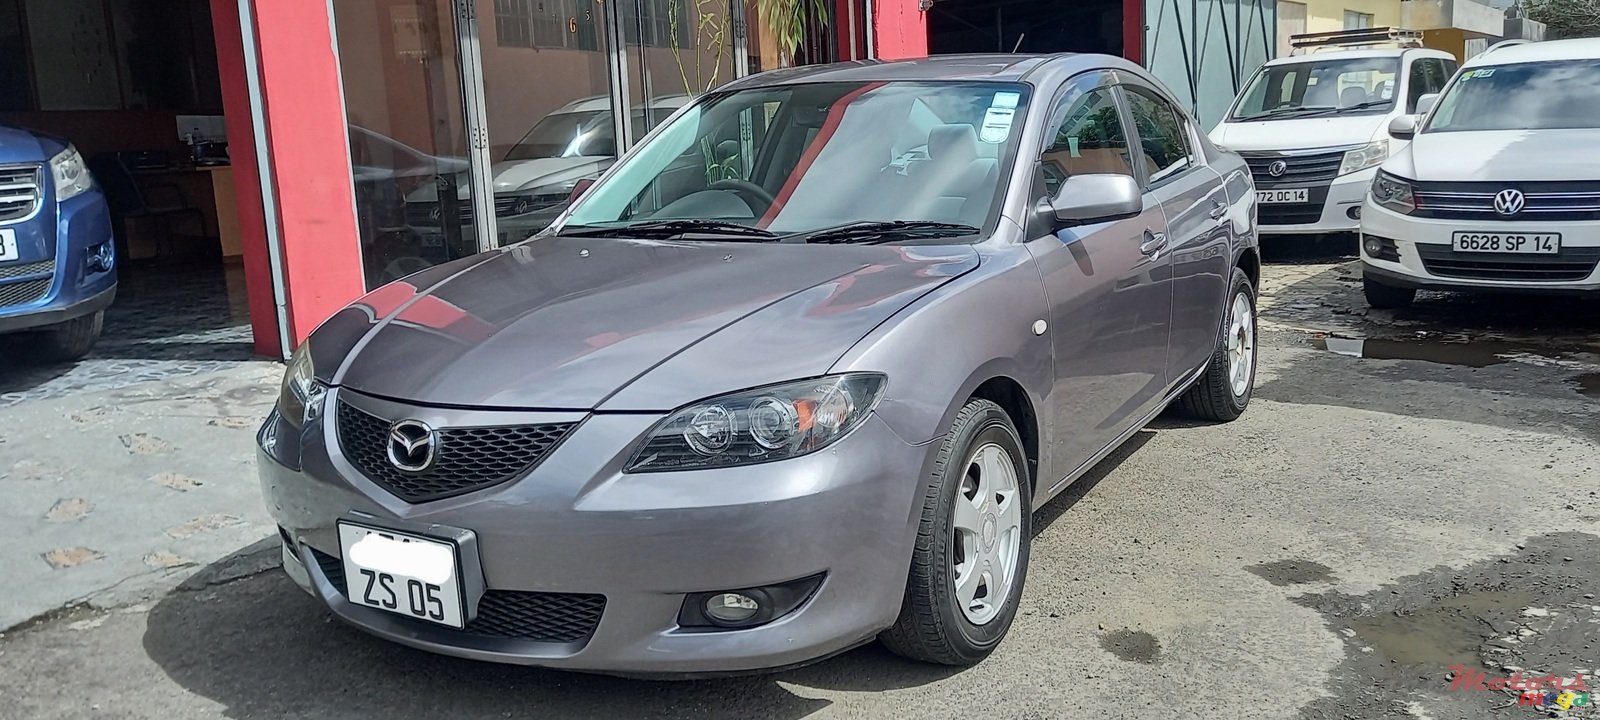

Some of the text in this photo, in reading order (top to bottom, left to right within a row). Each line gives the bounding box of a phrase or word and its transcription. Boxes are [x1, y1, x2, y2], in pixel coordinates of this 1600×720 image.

[1276, 191, 1291, 202] OC
[1293, 190, 1305, 201] 14
[1460, 234, 1553, 252] 6628 SP 14
[360, 568, 445, 621] ZS 05
